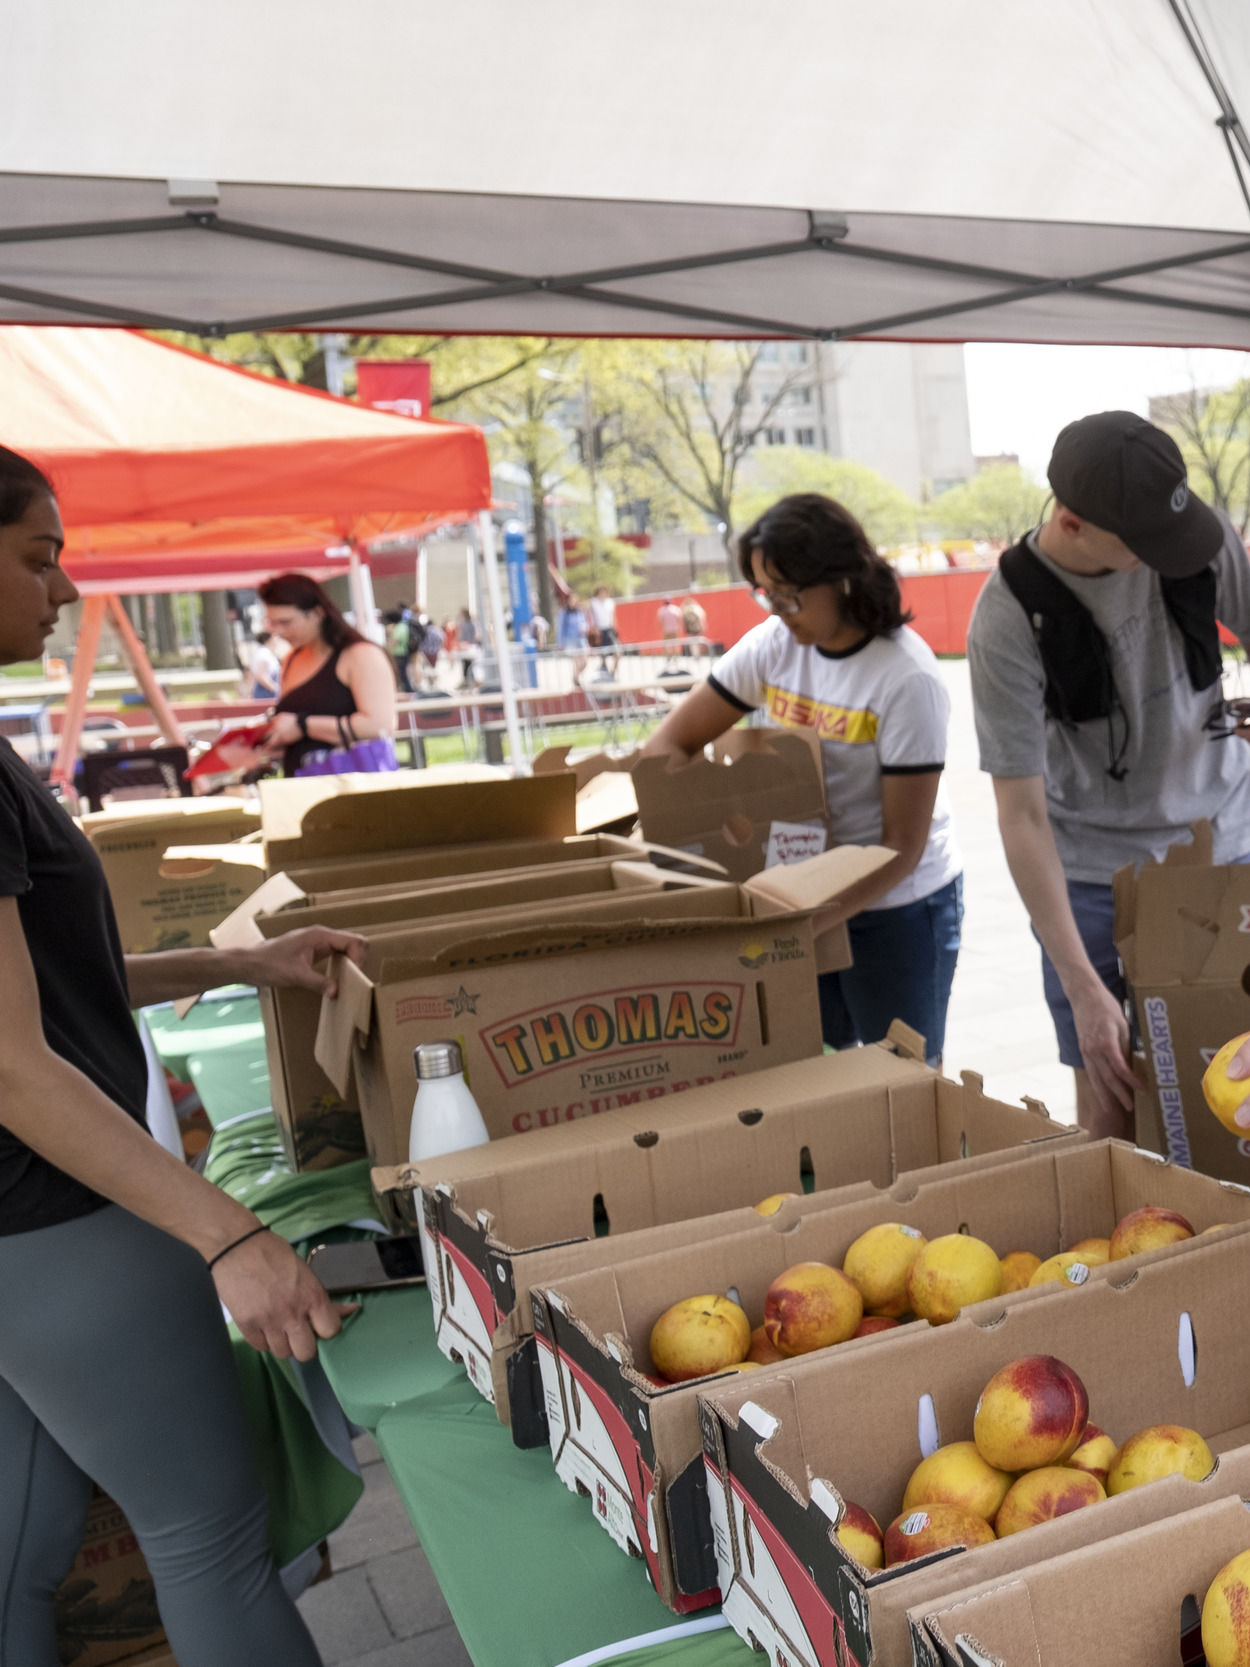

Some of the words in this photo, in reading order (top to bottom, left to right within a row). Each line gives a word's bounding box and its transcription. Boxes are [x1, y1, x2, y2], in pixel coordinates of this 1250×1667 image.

[493, 991, 732, 1075] THOMAS
[1148, 1000, 1176, 1083] HEARTS
[580, 1061, 671, 1089] PREMIUM
